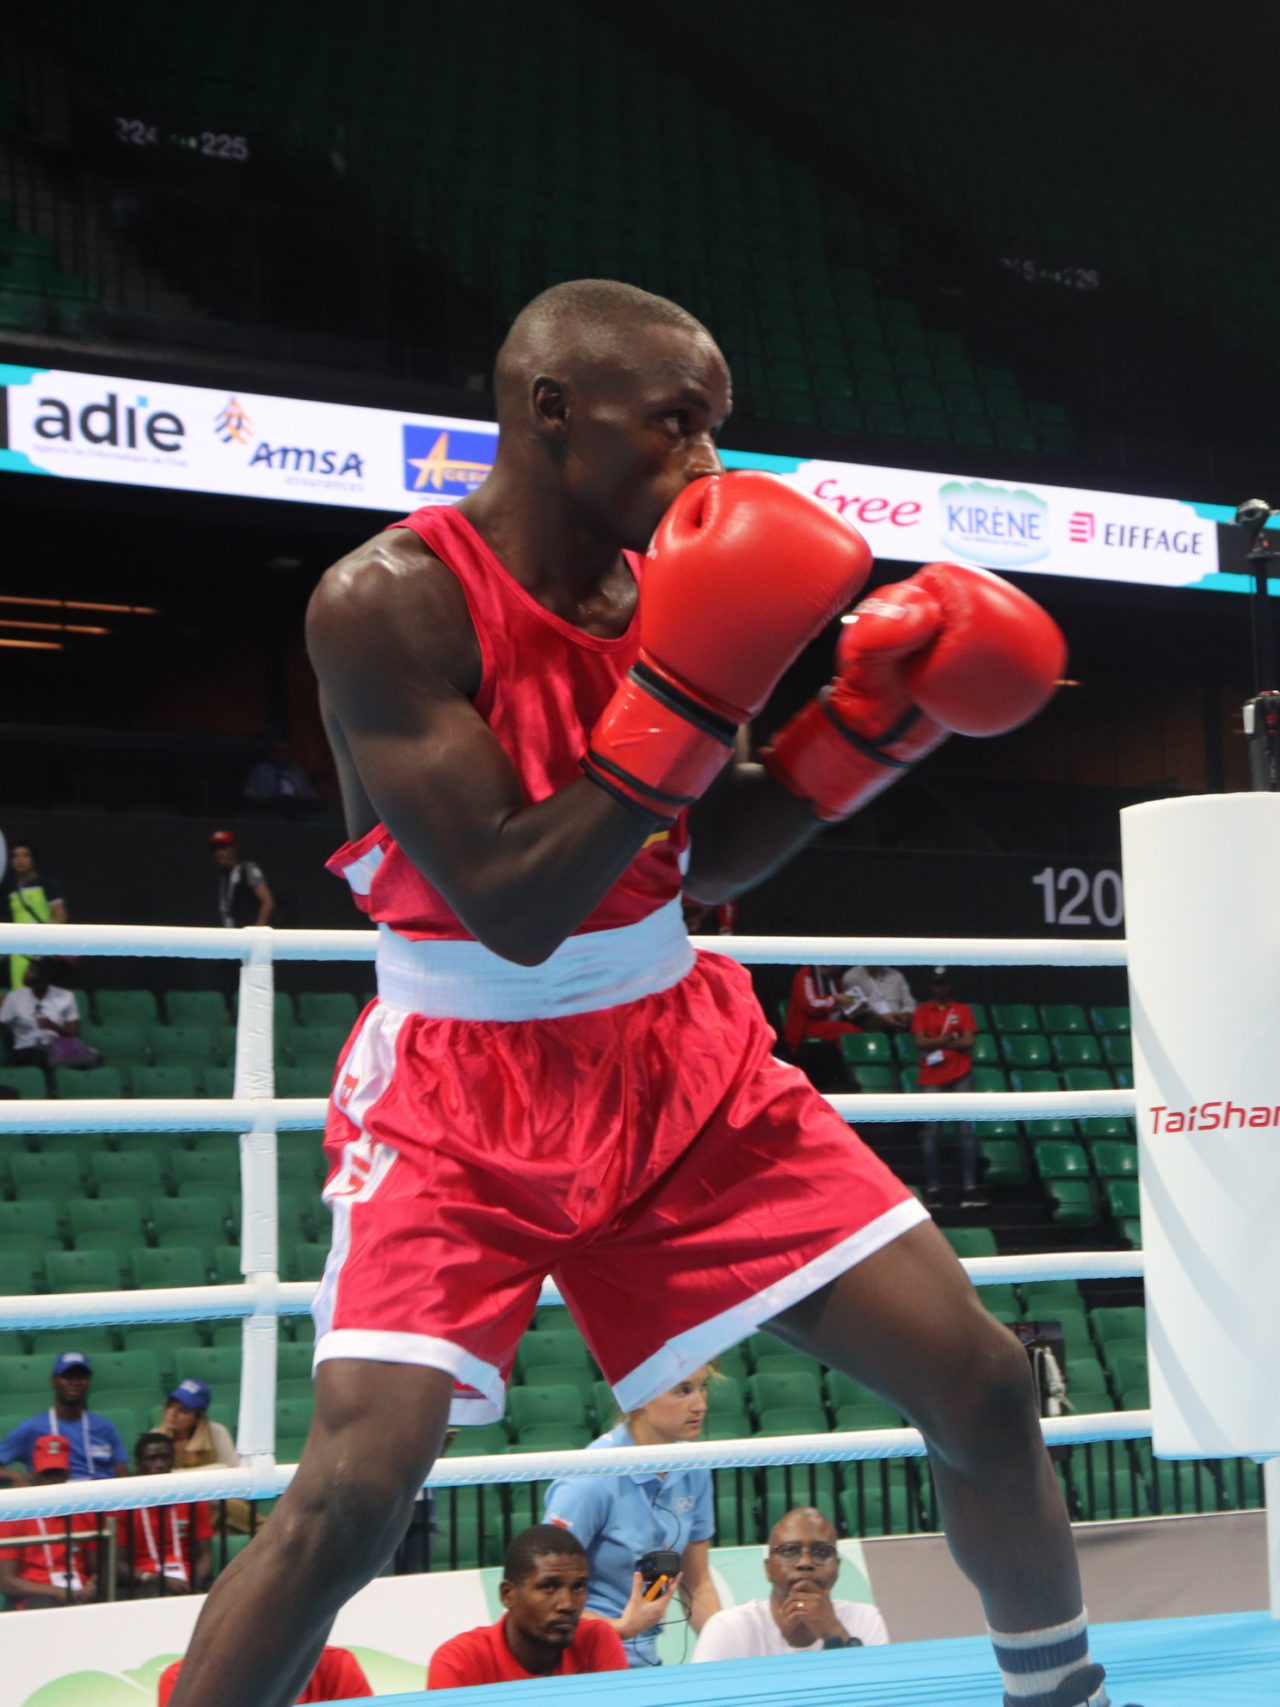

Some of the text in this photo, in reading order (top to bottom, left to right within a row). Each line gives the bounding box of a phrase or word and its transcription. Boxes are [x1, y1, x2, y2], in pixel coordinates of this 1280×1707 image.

[201, 131, 249, 161] 225
[34, 392, 186, 453] adie
[1104, 522, 1204, 554] EIFFAGE
[1032, 866, 1124, 927] 120
